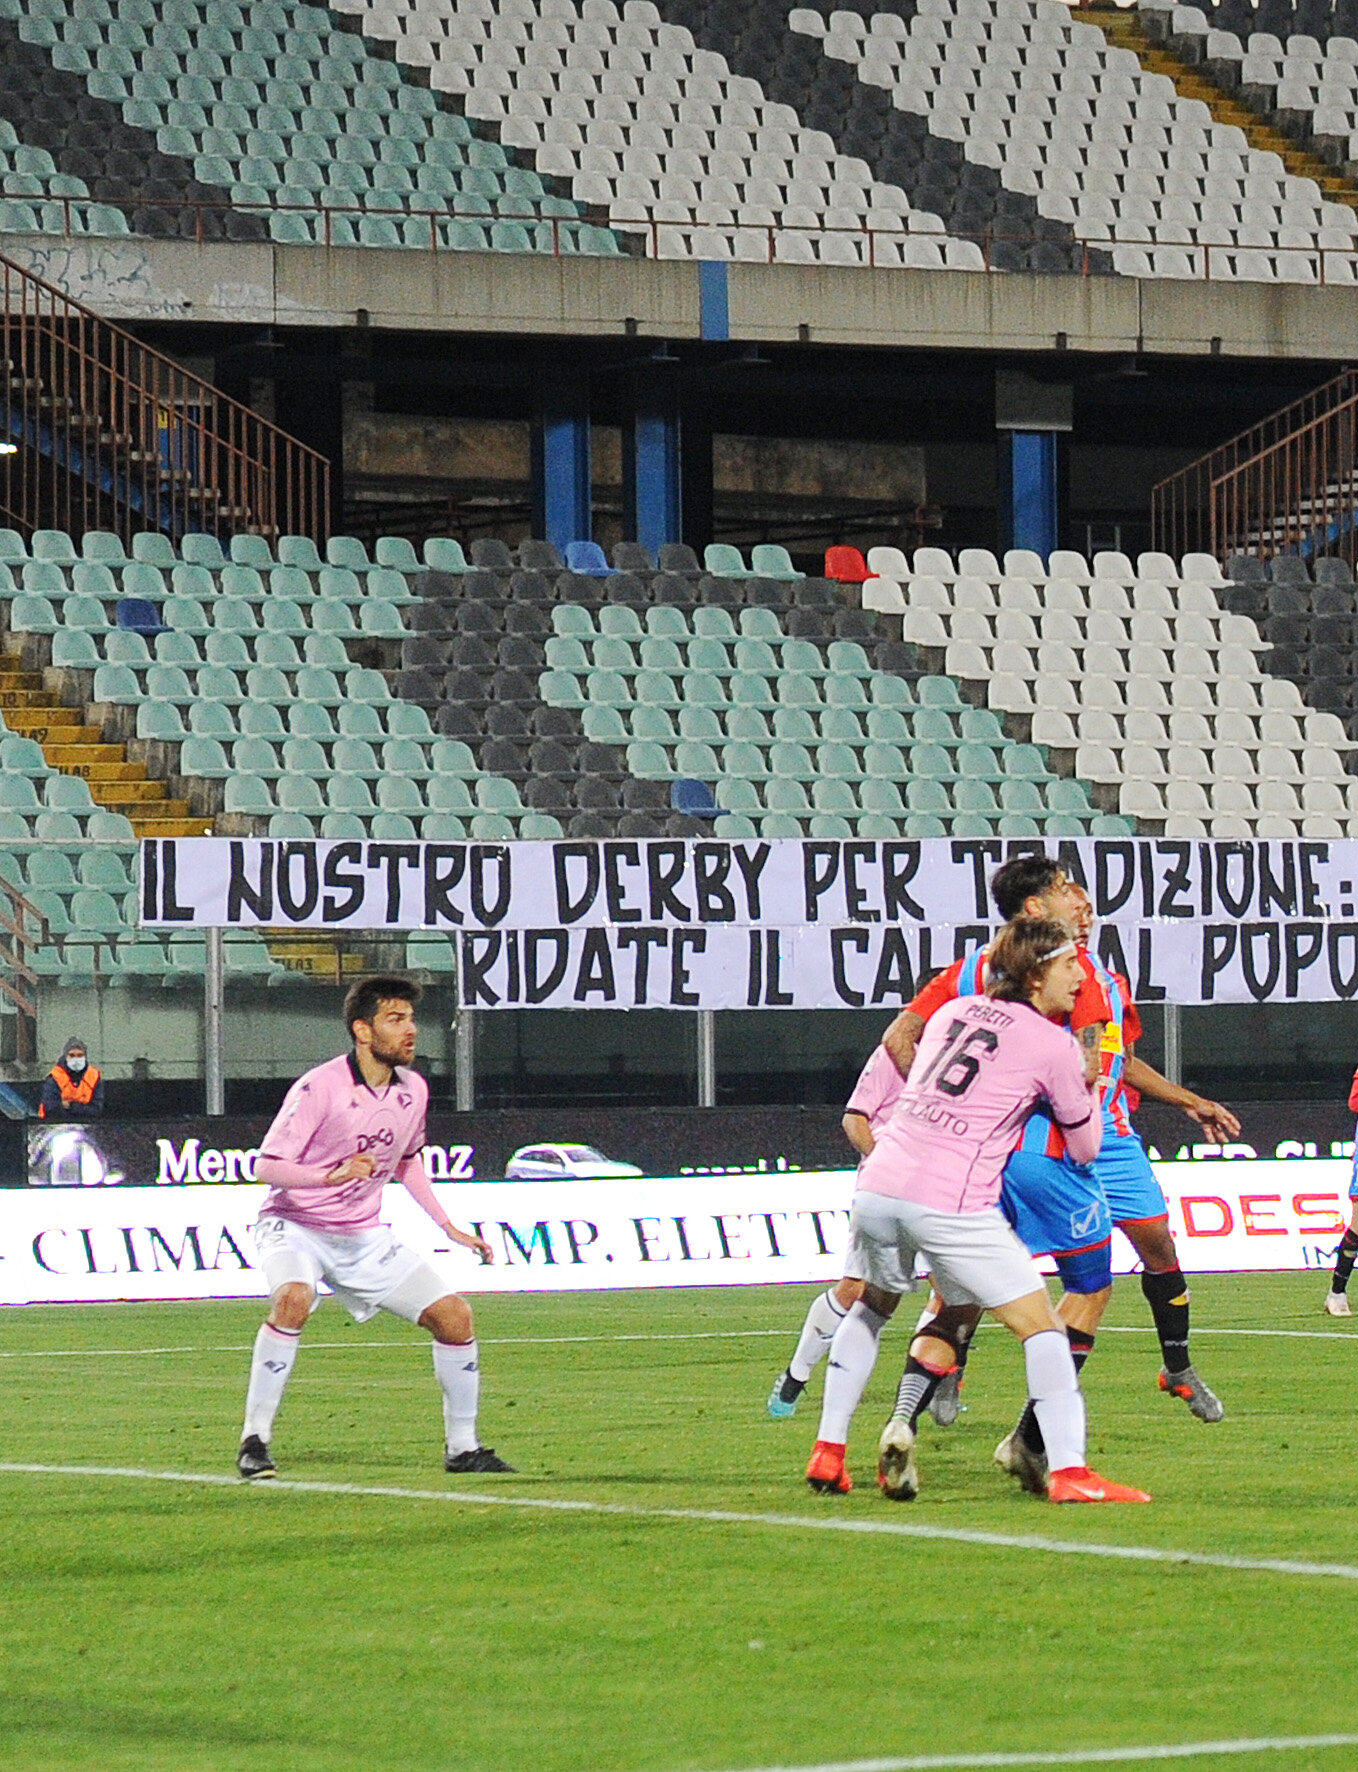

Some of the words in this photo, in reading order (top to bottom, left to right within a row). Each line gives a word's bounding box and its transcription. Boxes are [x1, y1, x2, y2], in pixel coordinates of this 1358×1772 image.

[143, 839, 195, 921] IL
[227, 840, 511, 926] NOSTRO
[552, 841, 772, 922] DERBY
[803, 840, 925, 922] PER
[463, 927, 707, 1006] RIDATE
[747, 929, 794, 1007] IL
[1096, 923, 1166, 1002] AL
[919, 1017, 1001, 1098] 16
